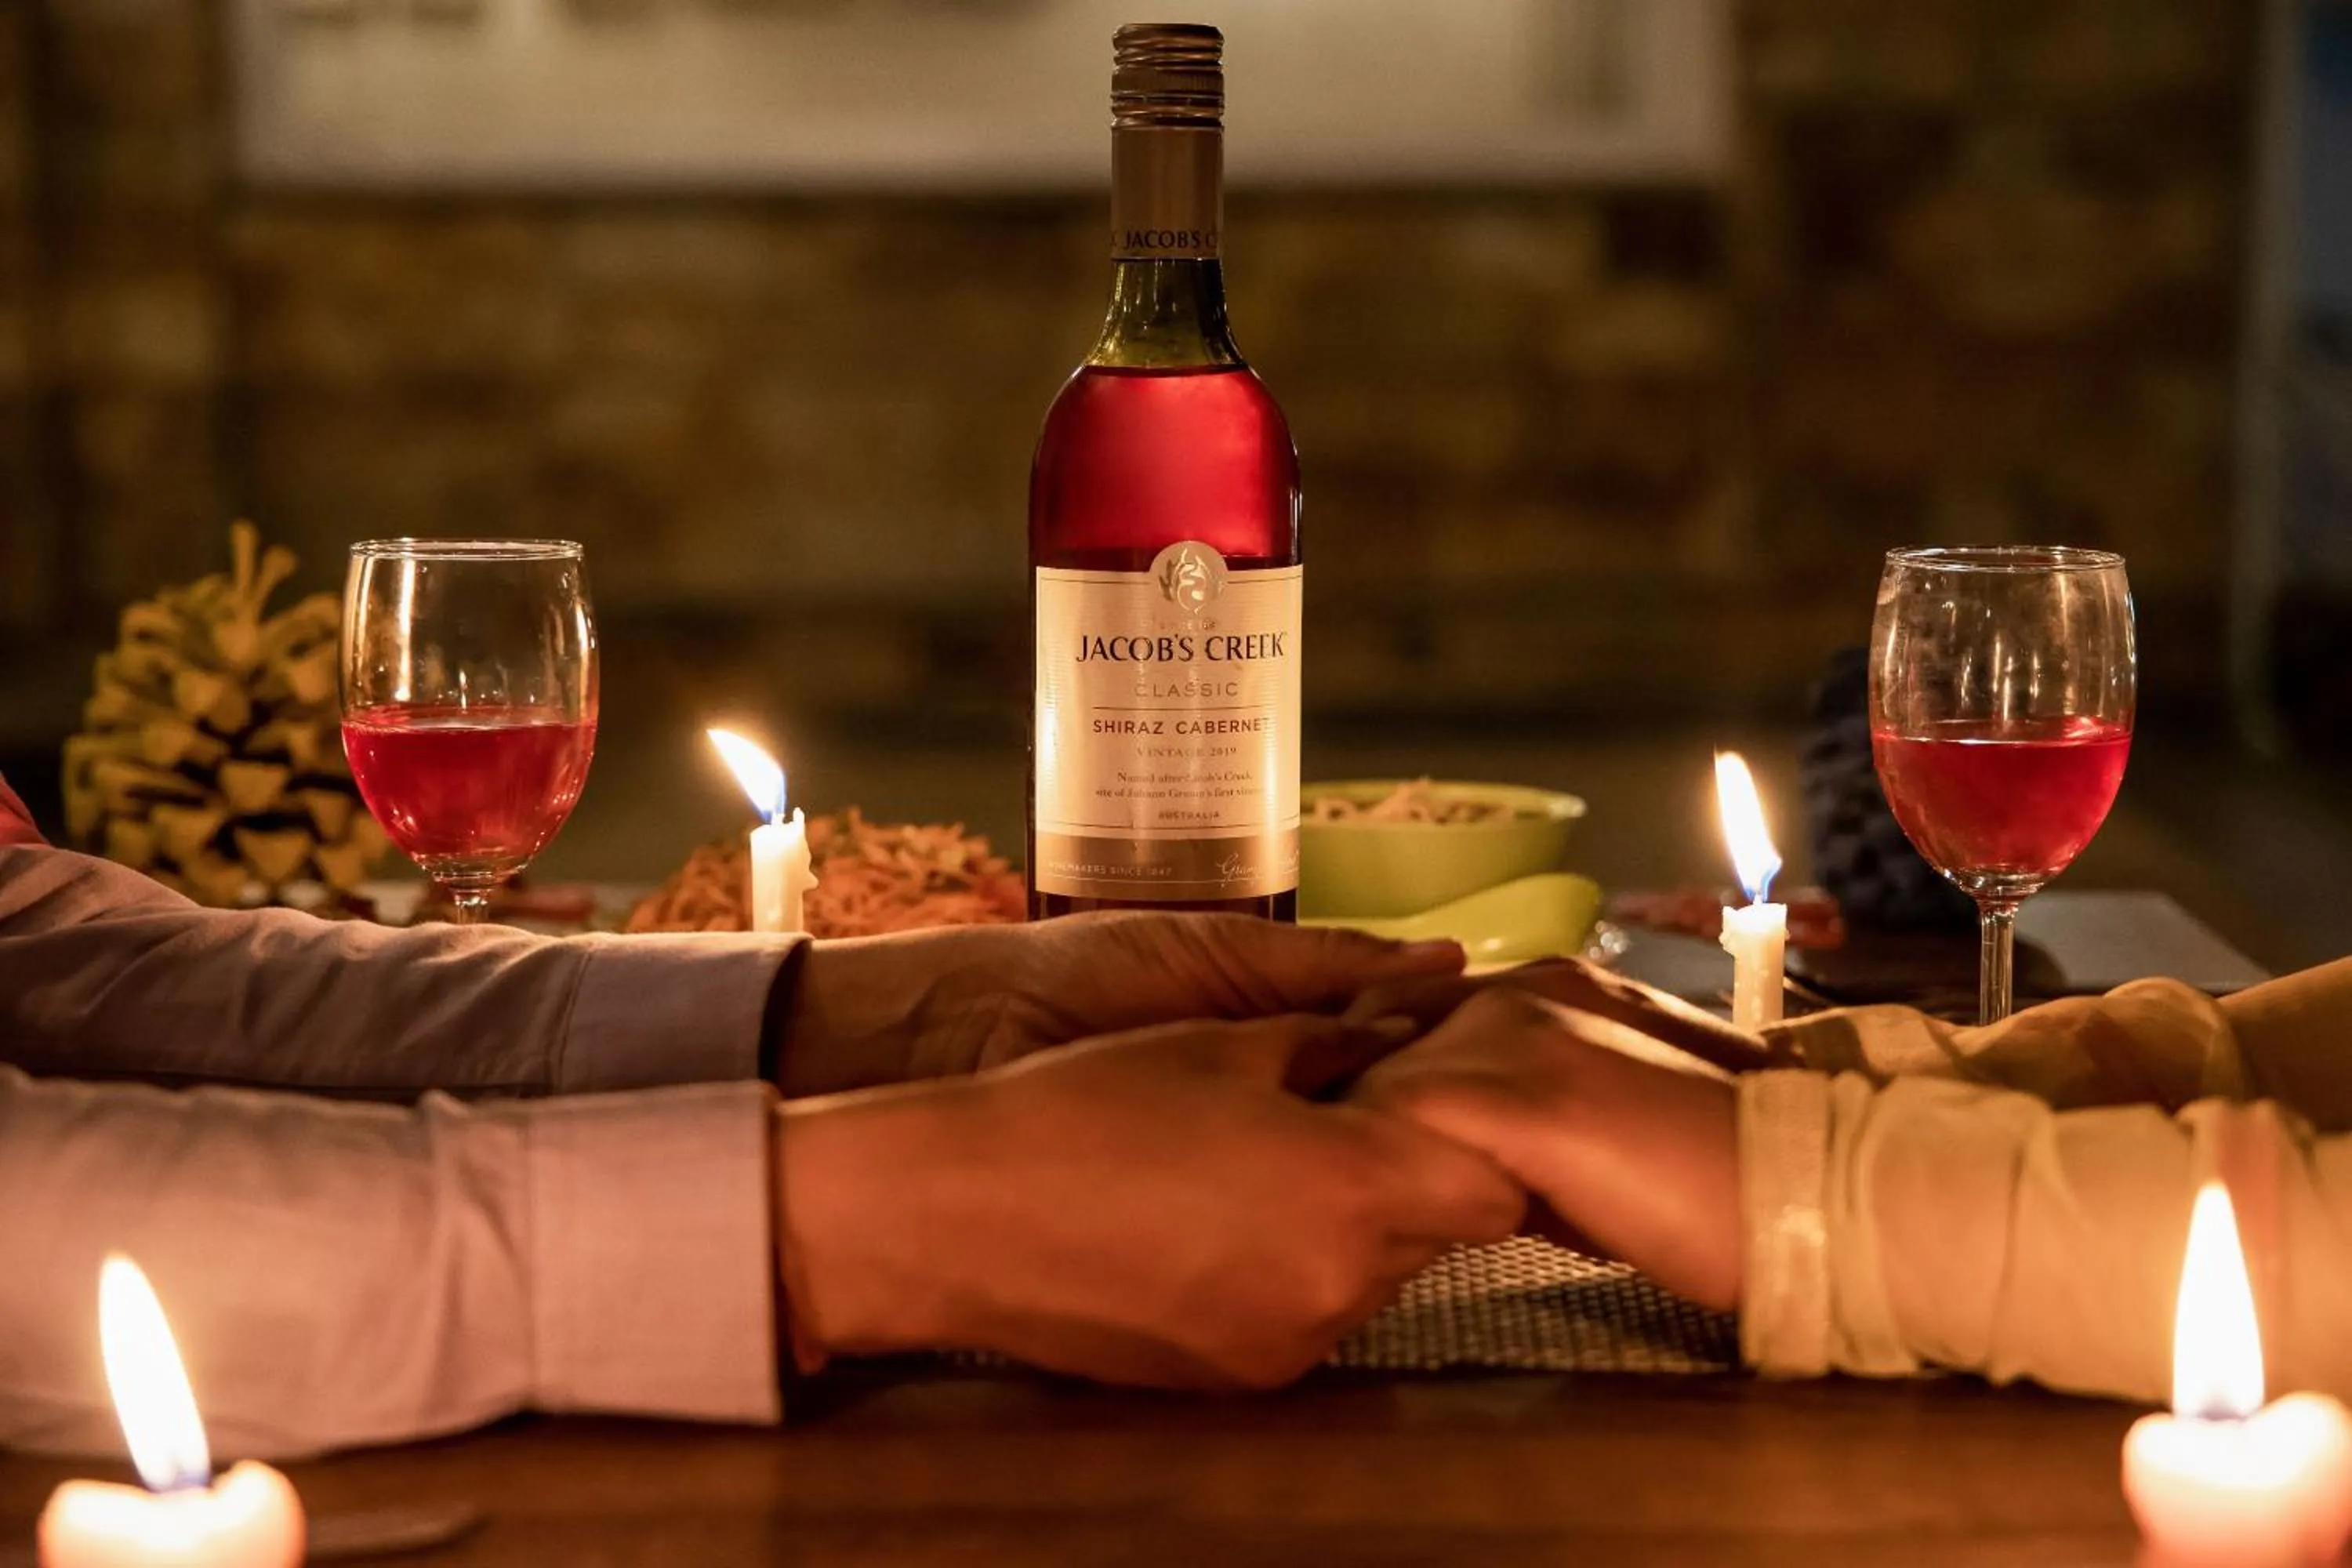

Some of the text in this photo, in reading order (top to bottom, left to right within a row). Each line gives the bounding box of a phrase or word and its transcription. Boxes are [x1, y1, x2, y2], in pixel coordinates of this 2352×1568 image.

[1076, 632, 1284, 662] JACOB'S CREEK
[1134, 682, 1239, 697] CLASSIC
[1093, 717, 1270, 735] SHIRAZ CABERNET
[1137, 746, 1205, 758] VINTAGE
[1158, 811, 1220, 820] AUSTRALIA
[1109, 866, 1142, 877] SINCE
